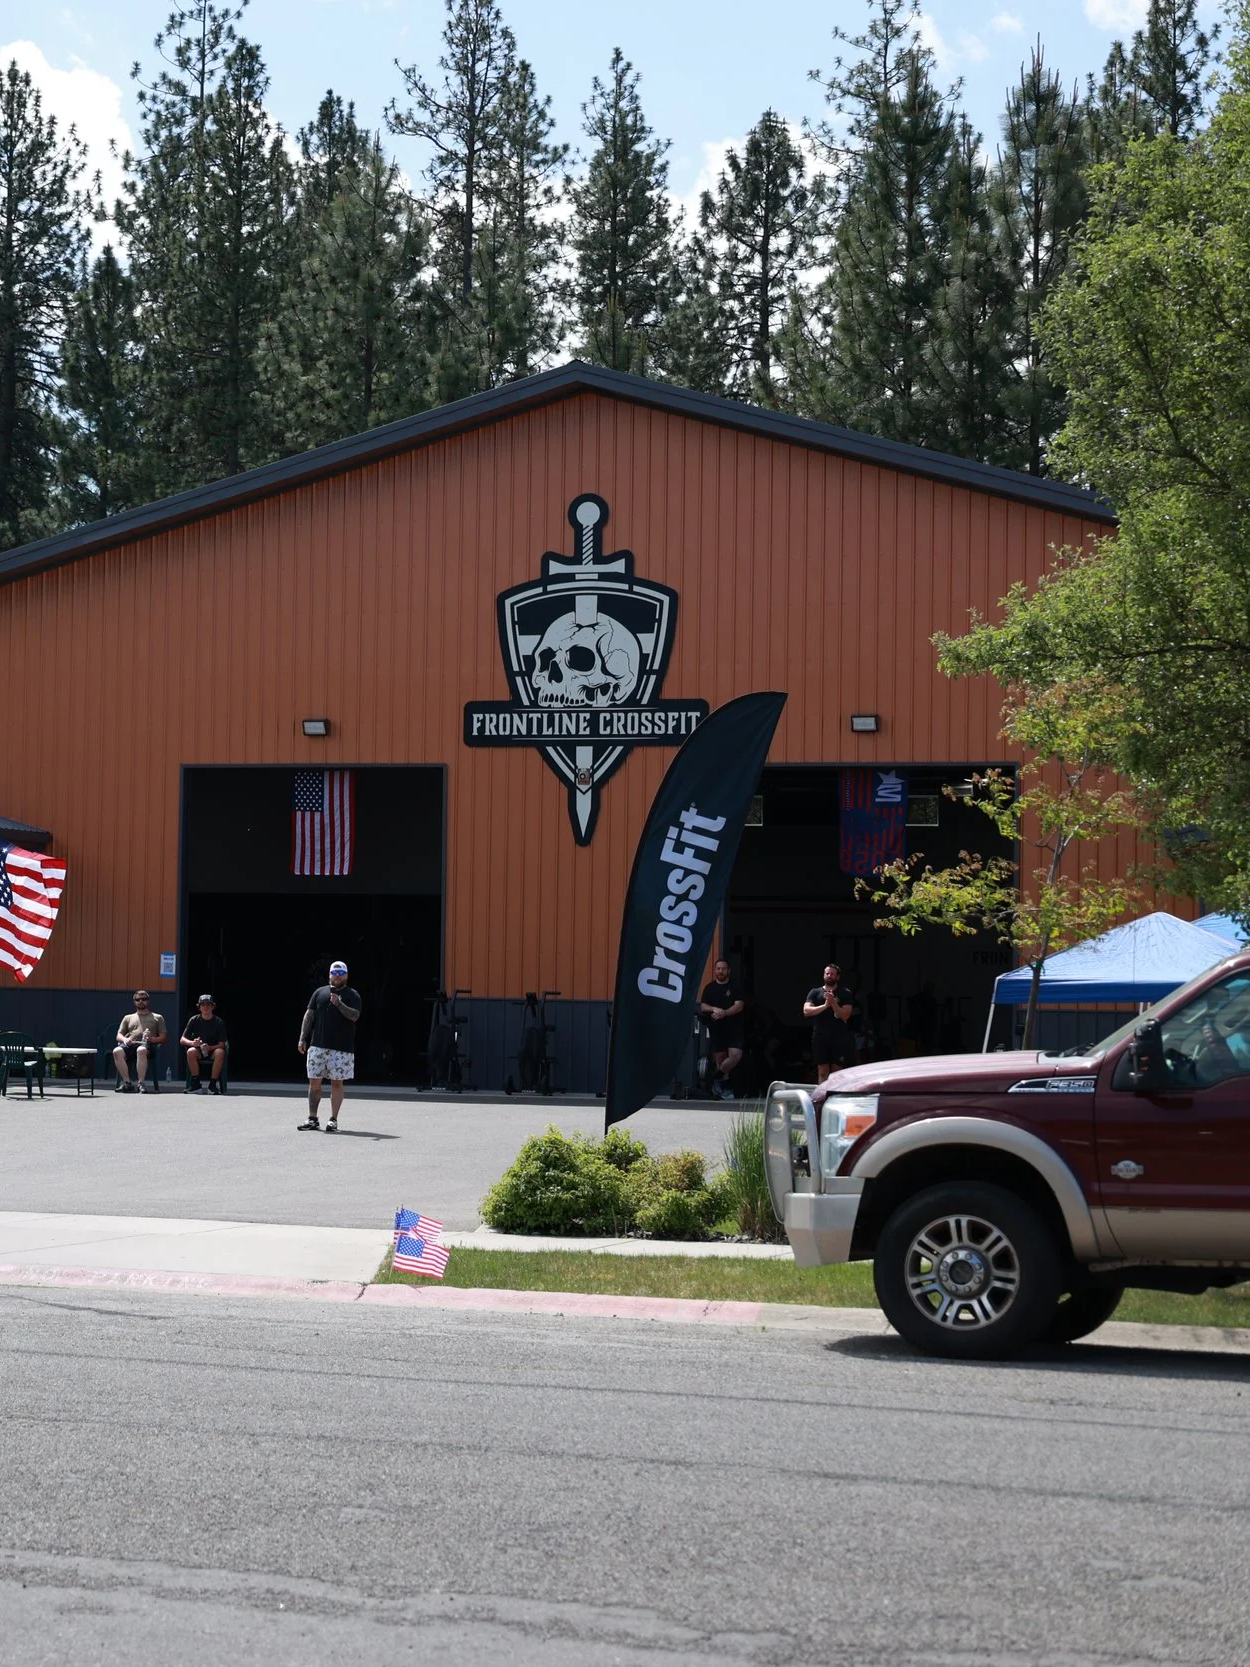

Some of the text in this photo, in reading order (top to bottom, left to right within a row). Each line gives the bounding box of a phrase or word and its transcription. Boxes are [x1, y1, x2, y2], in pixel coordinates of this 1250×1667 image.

[471, 711, 701, 736] FRONTLINE CROSSFIT
[636, 806, 727, 1004] CrossFit
